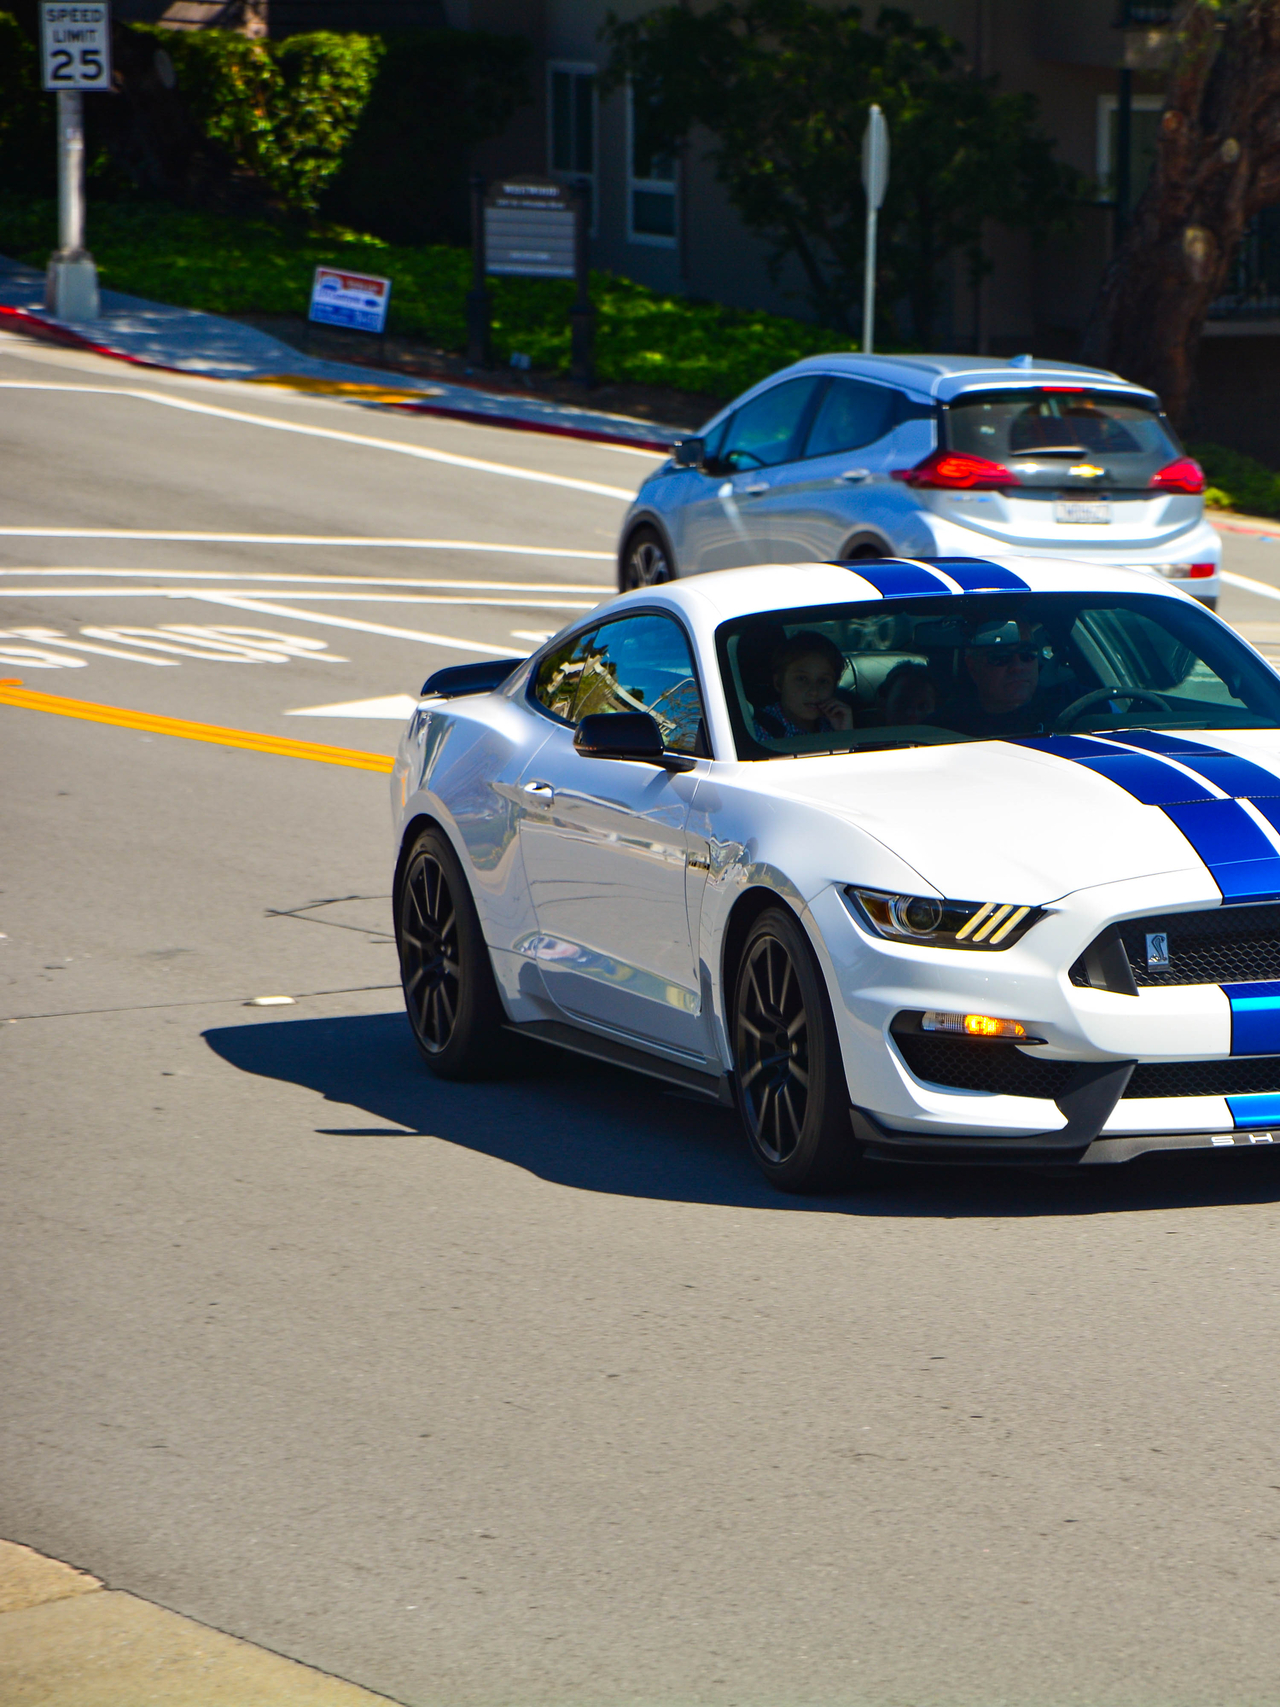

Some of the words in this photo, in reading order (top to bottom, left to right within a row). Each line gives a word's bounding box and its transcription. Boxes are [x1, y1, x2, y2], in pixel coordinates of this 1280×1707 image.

[46, 8, 103, 23] SPEED
[52, 29, 98, 43] LIMIT
[50, 49, 104, 81] 25
